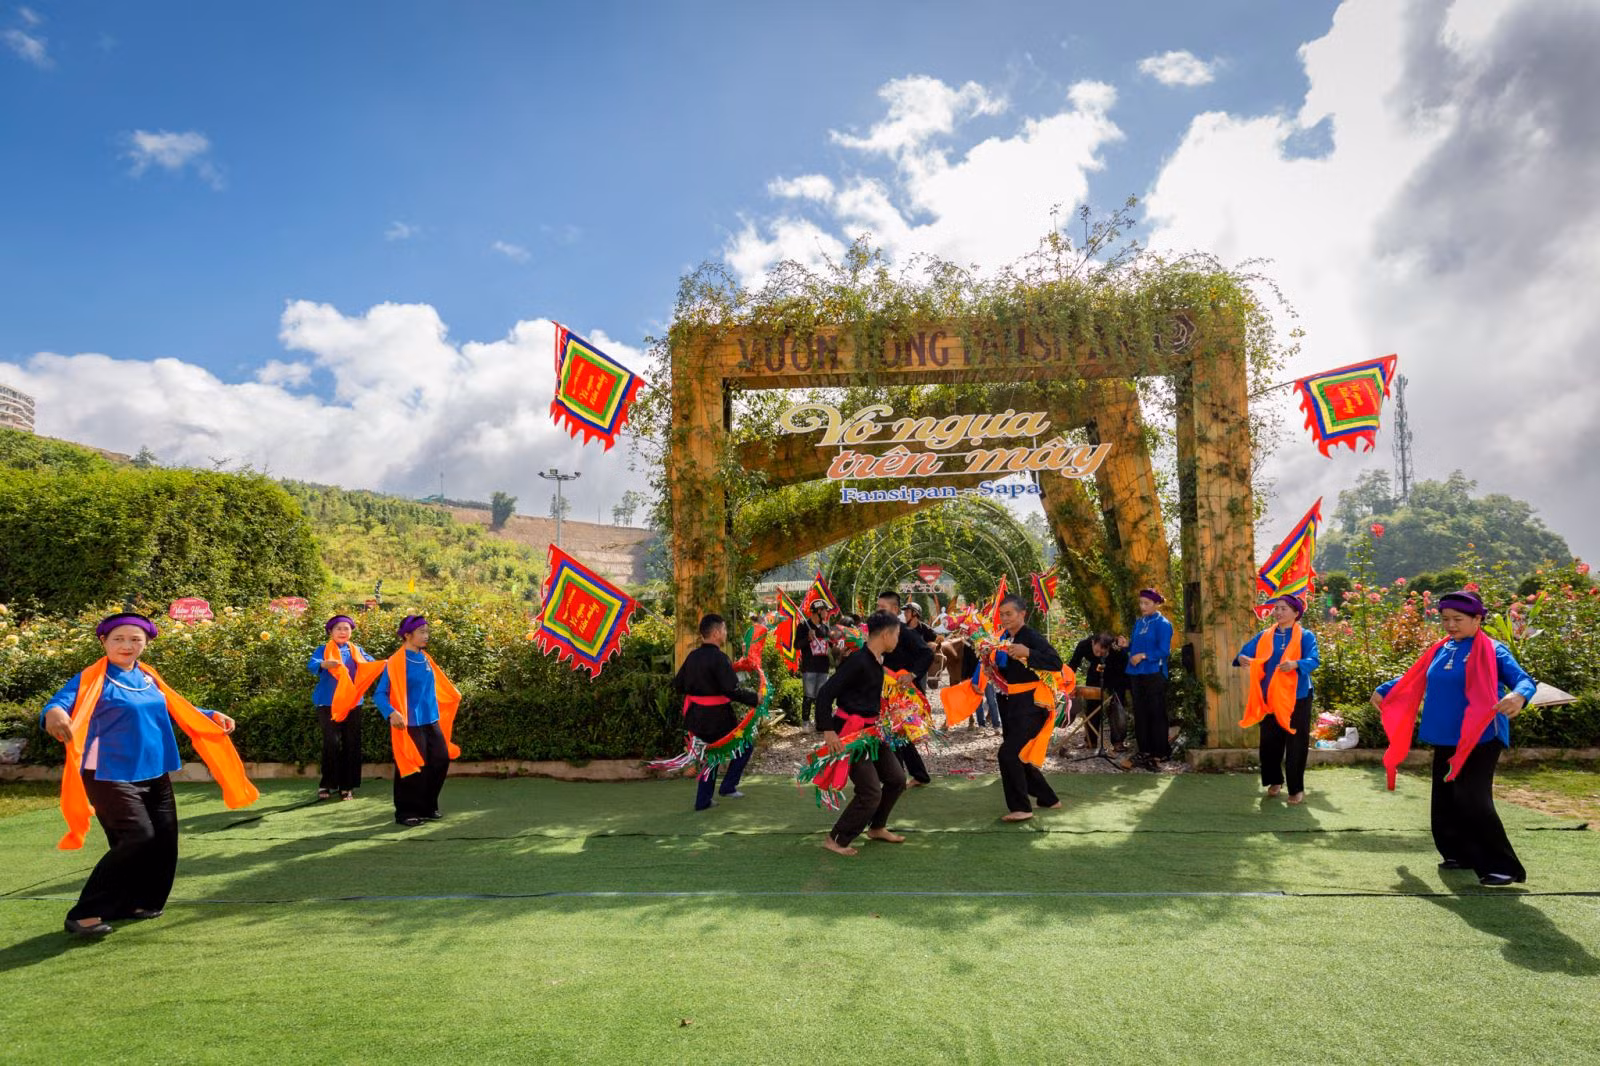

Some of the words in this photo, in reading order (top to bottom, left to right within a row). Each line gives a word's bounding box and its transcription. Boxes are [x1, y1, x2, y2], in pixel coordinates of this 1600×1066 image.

[780, 403, 894, 446] Vó
[892, 409, 1050, 449] ngựa
[827, 444, 943, 480] trên
[965, 436, 1112, 479] mây
[840, 486, 958, 503] Fansipan
[978, 480, 1042, 499] Sapa
